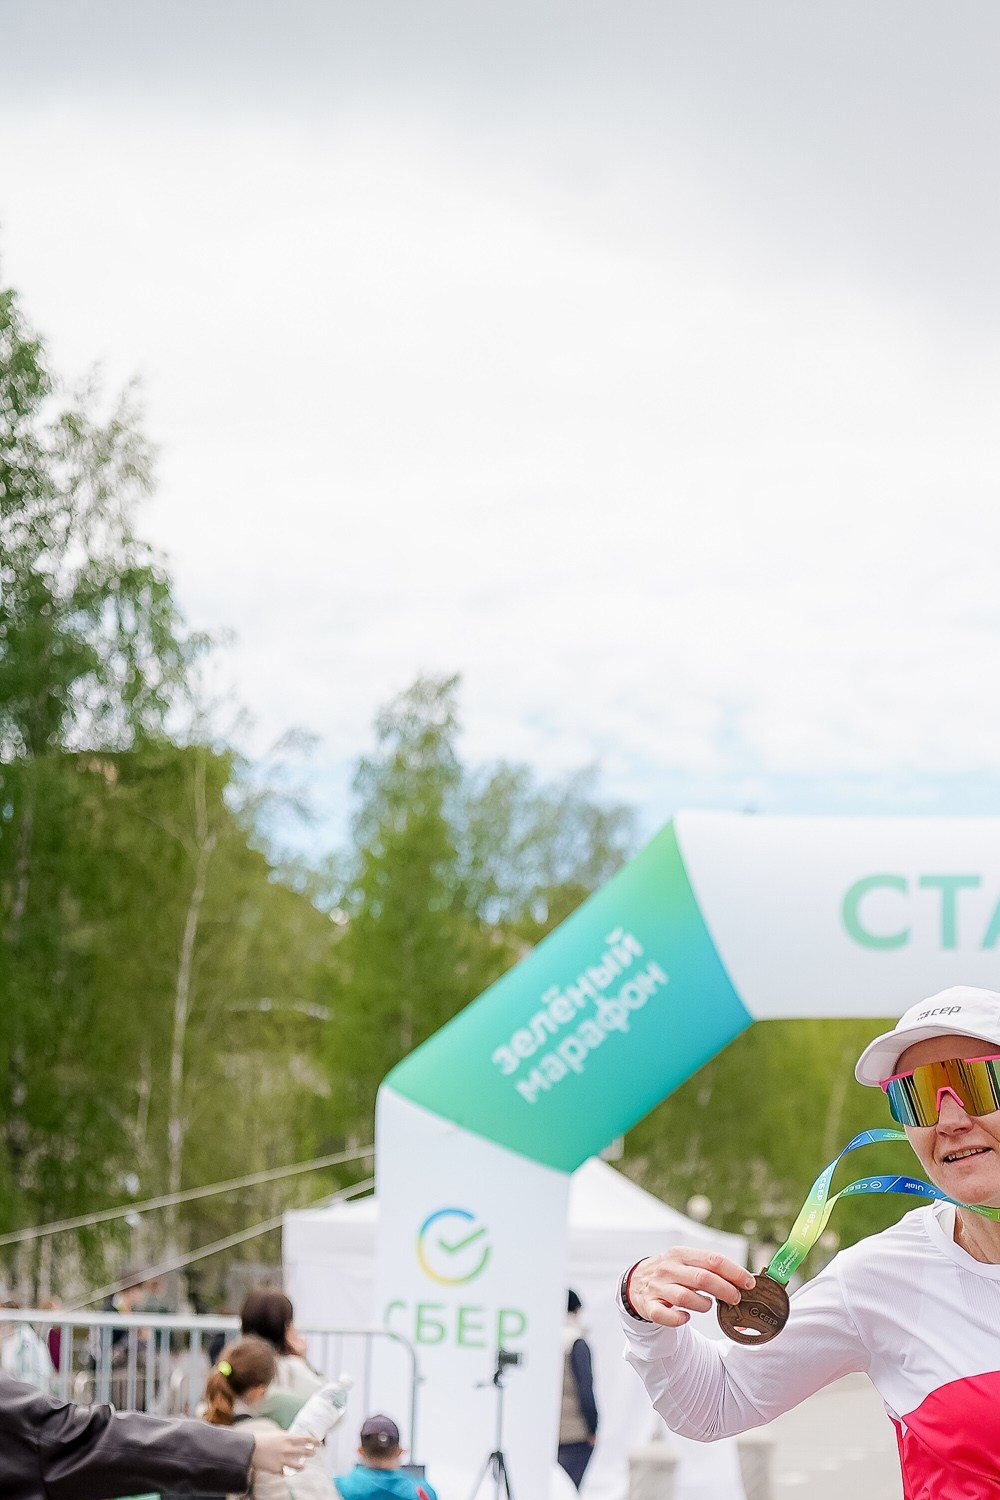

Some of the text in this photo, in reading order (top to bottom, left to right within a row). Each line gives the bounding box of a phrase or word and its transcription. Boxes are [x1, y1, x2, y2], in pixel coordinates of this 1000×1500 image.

[492, 926, 644, 1076] зелёный
[515, 961, 669, 1104] марафон
[760, 1313, 778, 1326] СБЕР
